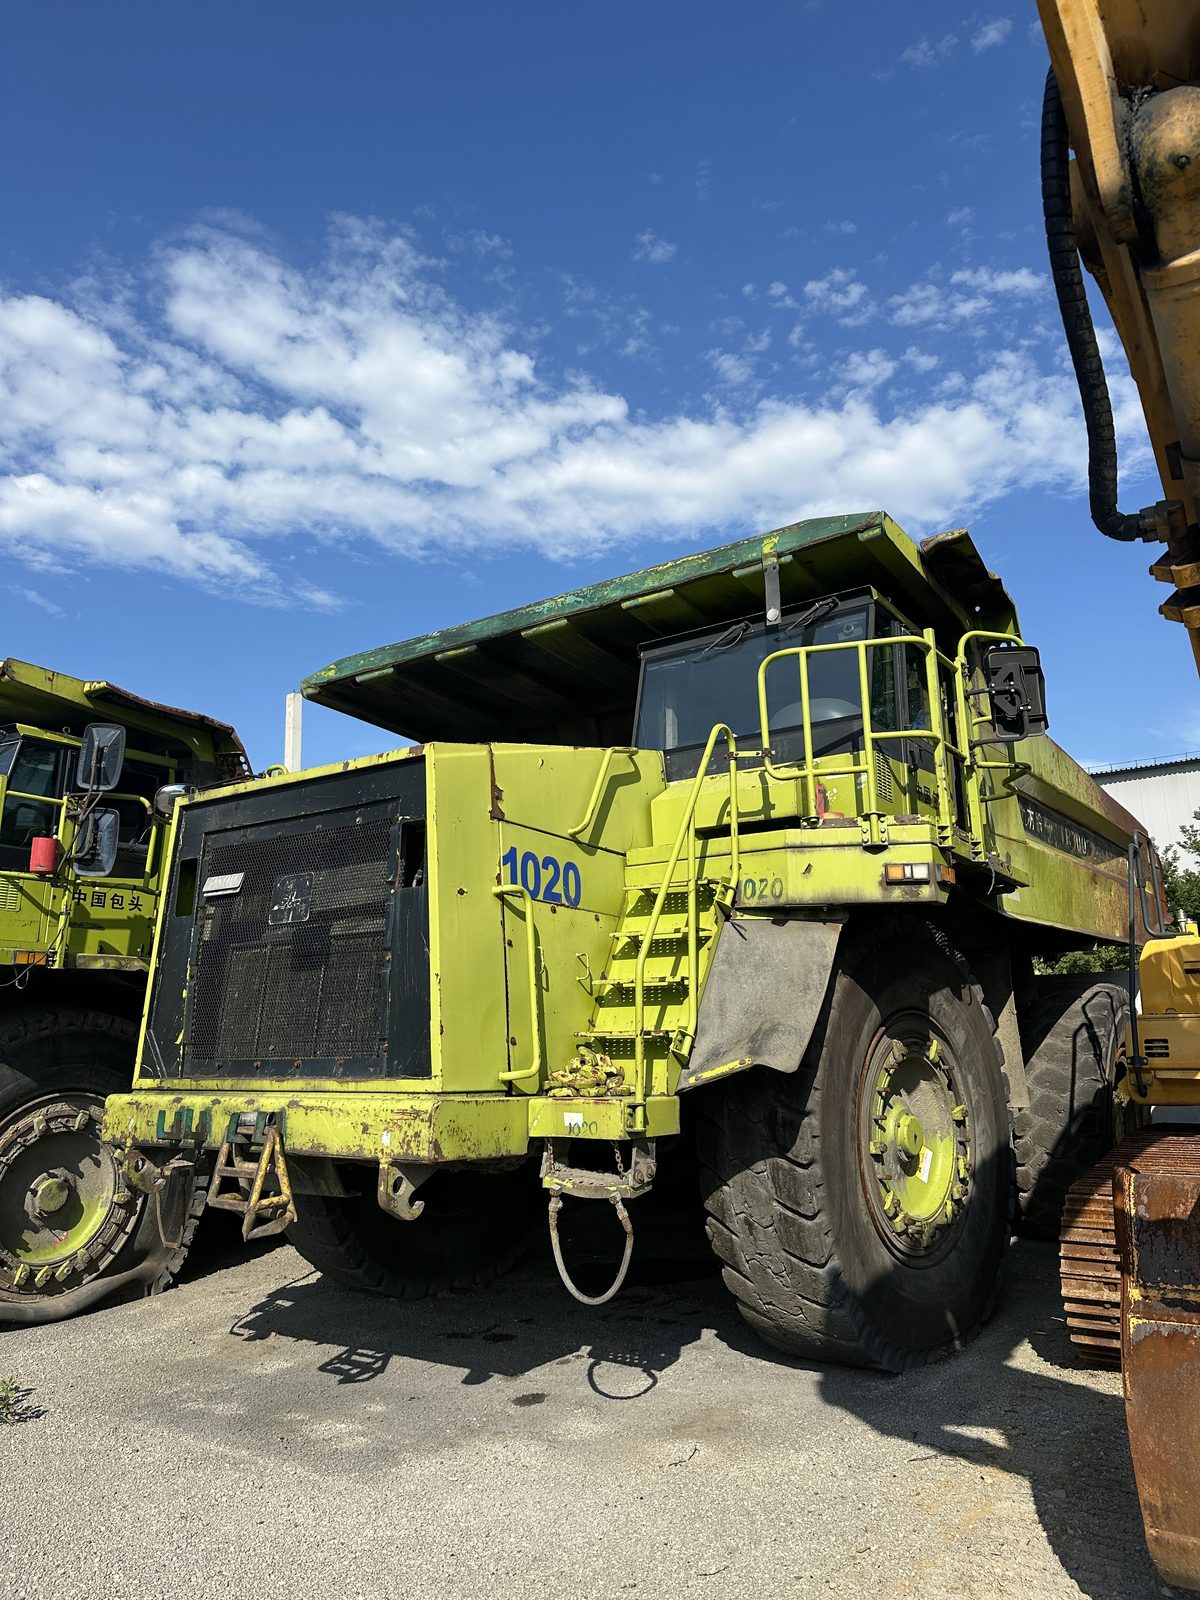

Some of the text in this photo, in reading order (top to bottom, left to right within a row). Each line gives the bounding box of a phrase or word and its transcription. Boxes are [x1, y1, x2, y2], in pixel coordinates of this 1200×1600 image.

[502, 846, 582, 908] 1020
[71, 889, 143, 912] 中国包头
